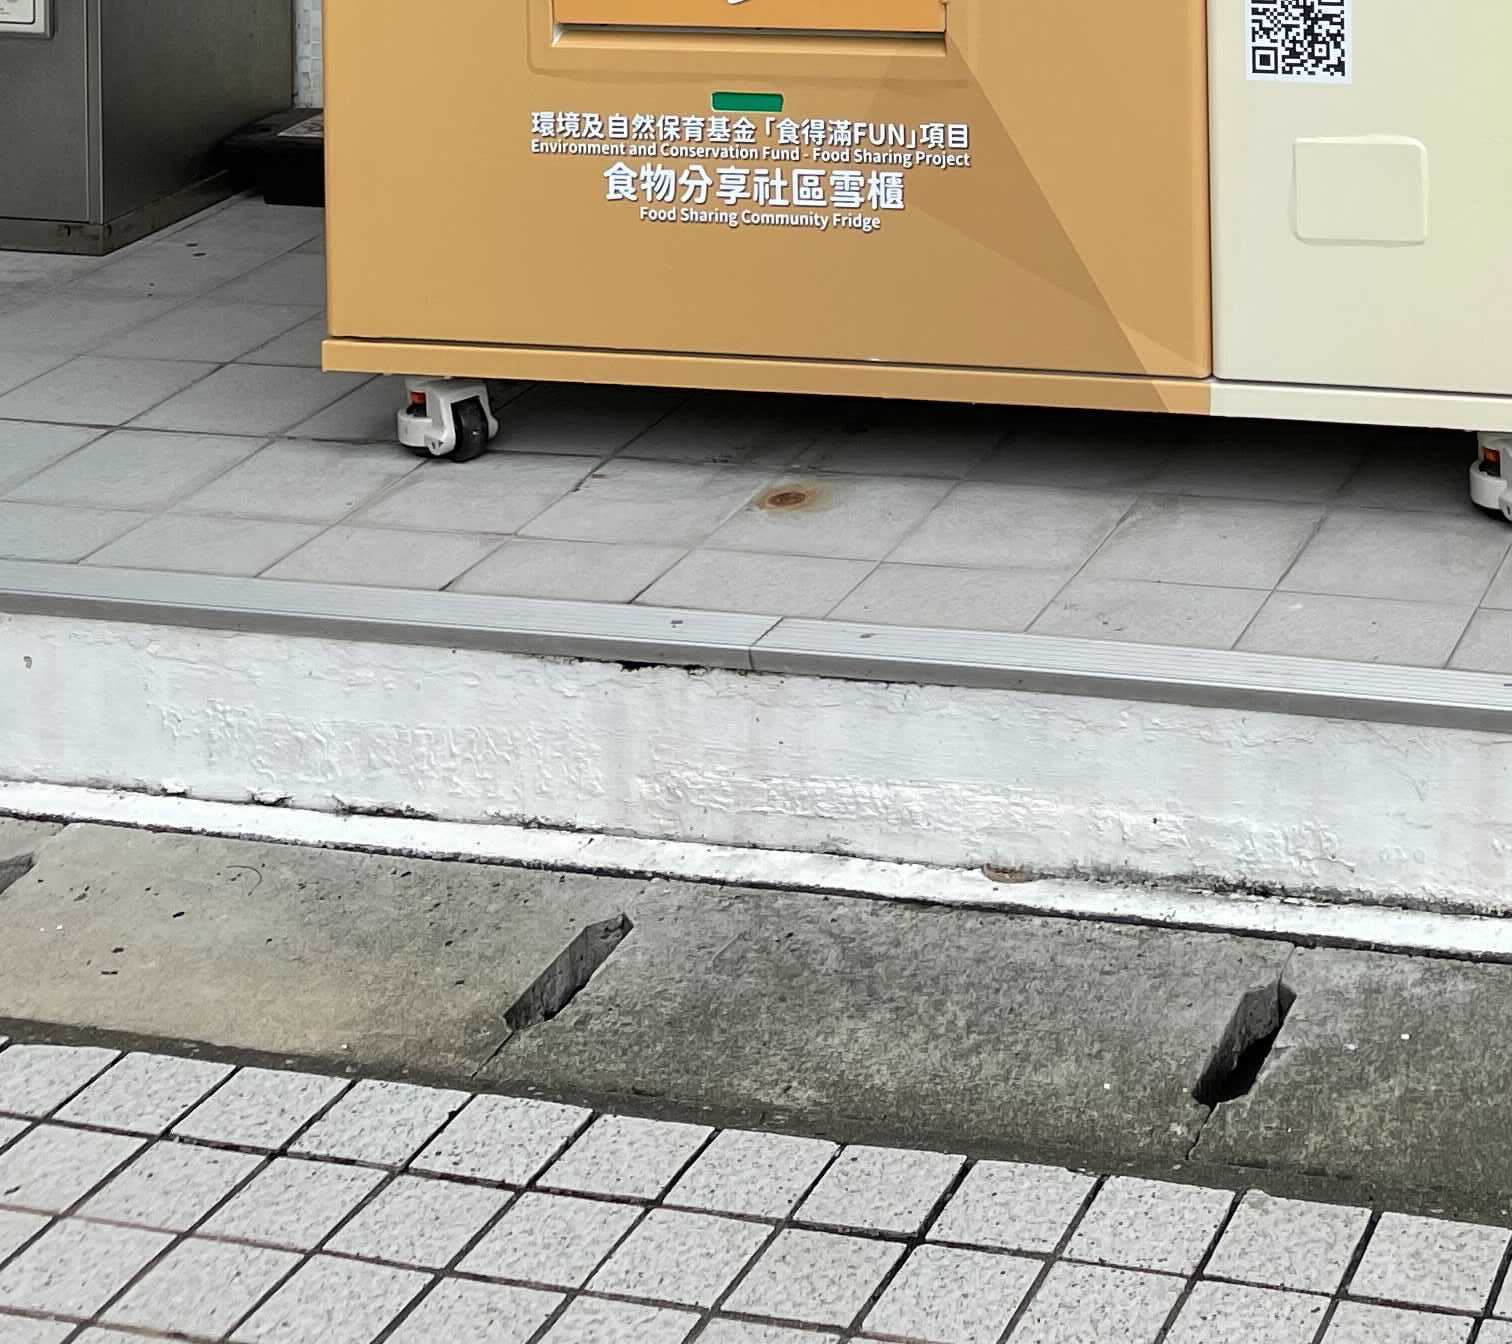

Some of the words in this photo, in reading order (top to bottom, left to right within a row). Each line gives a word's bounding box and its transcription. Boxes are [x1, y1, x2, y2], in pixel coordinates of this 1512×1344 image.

[531, 139, 626, 156] Environment
[629, 142, 659, 157] and
[661, 143, 759, 161] Conservation
[762, 146, 800, 161] Fund
[812, 148, 850, 163] Food
[853, 150, 913, 169] Sharing
[915, 152, 971, 169] Project
[603, 161, 906, 211] 食物分享社區雪櫃
[639, 206, 677, 222] Food
[680, 208, 738, 227] Sharing
[741, 210, 828, 230] Community
[832, 212, 881, 232] Fridge
